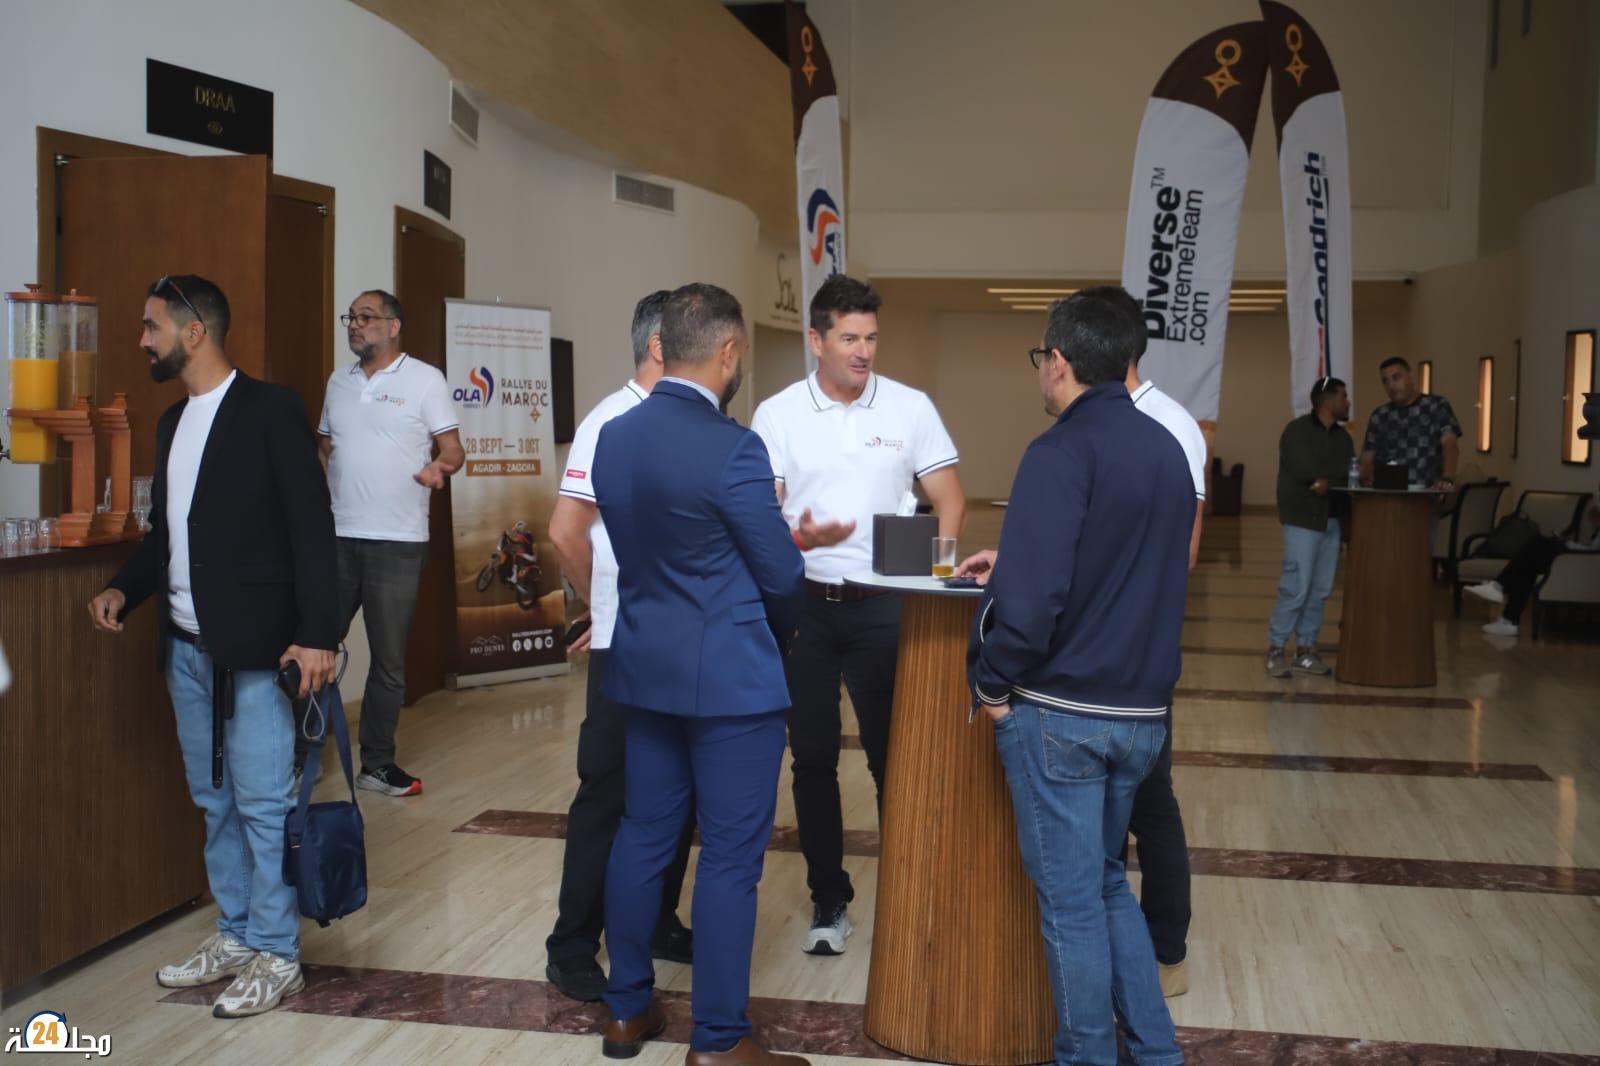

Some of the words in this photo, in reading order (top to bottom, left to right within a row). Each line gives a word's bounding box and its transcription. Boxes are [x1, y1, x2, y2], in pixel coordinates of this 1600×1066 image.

[1138, 185, 1181, 341] Diverse
[1167, 189, 1204, 343] ExtremeTeam
[1189, 290, 1210, 346] .com
[501, 379, 533, 390] RALLYE
[535, 380, 548, 390] DU
[453, 388, 481, 402] OLA
[502, 392, 549, 407] MAROC
[465, 438, 478, 454] 28
[480, 438, 502, 454] SEPT
[518, 439, 525, 454] 3
[526, 439, 540, 455] OCT
[473, 463, 501, 473] AGADIR
[507, 463, 536, 473] ZAGORA
